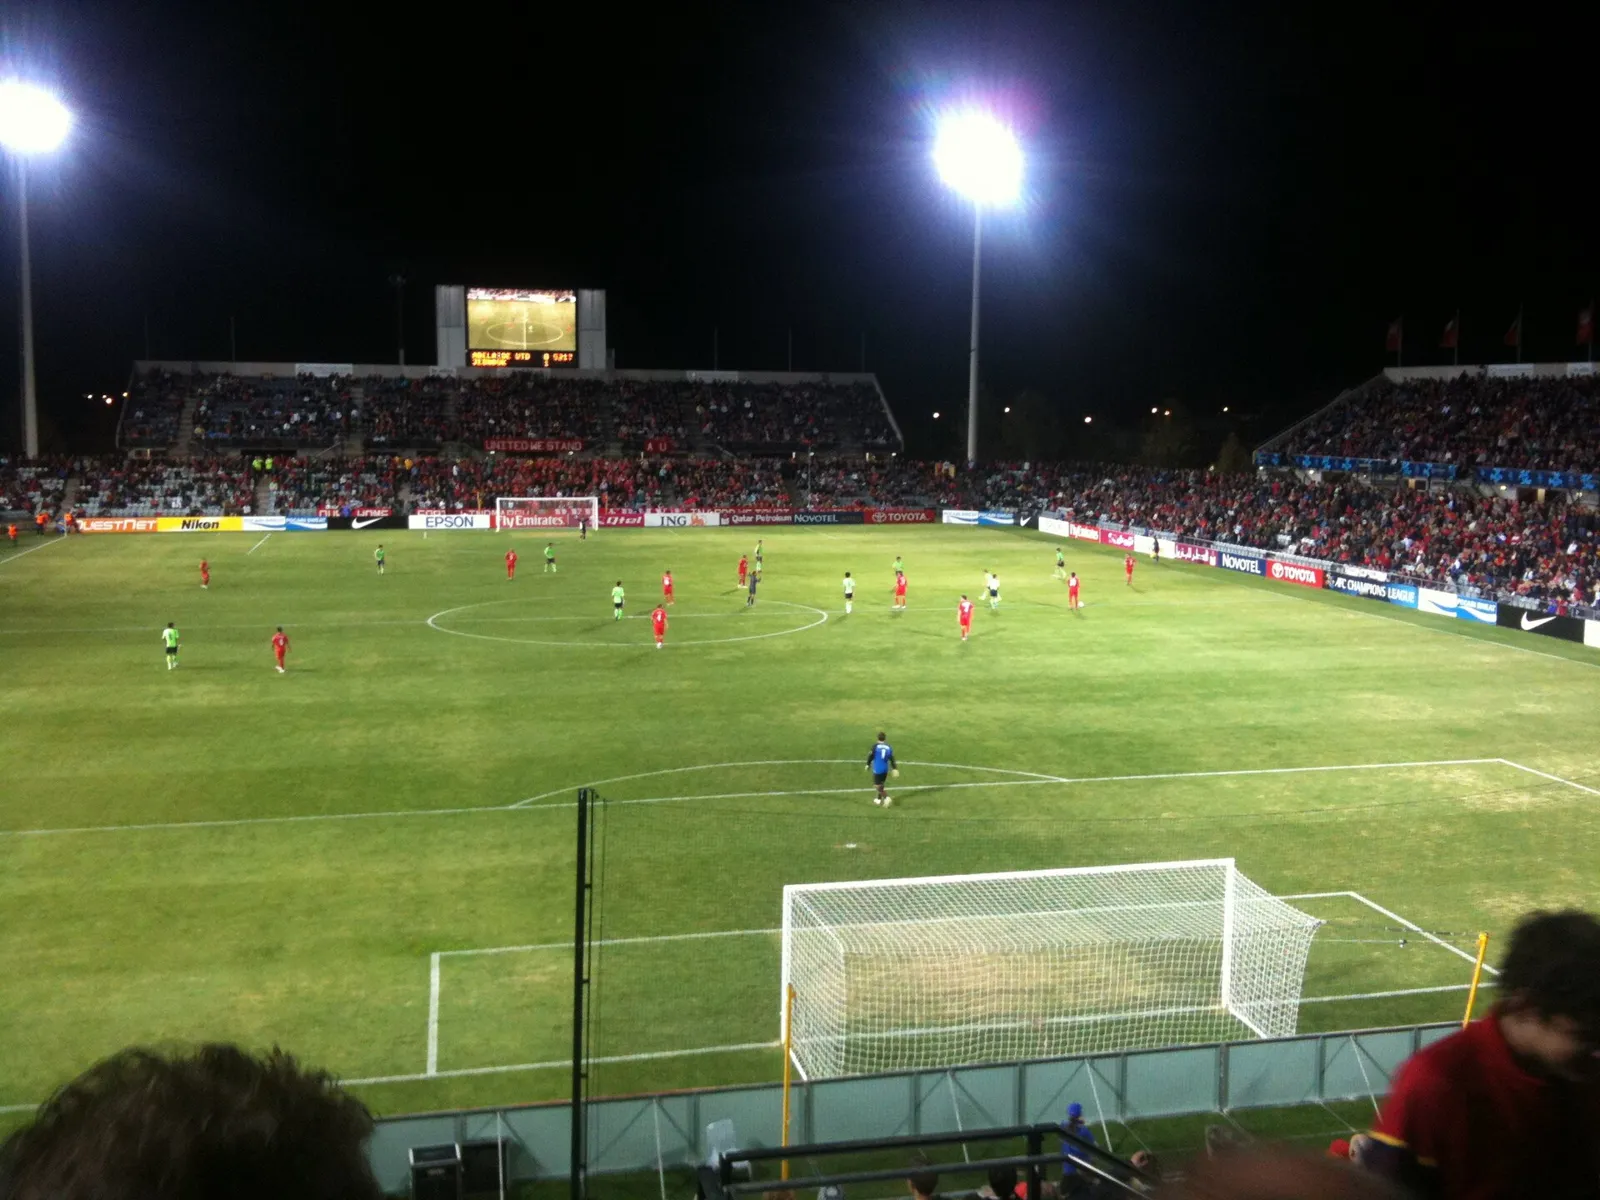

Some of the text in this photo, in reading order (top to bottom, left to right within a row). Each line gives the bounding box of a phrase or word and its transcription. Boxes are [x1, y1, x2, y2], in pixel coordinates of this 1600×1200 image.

[514, 352, 531, 361] UTD
[485, 440, 583, 451] UNITED WE STAND
[425, 516, 474, 528] EPSON
[515, 514, 564, 526] Emirates
[660, 515, 687, 526] ING
[732, 514, 792, 523] Qatar Petroleum
[794, 513, 838, 523] NOVOTEL
[887, 512, 927, 521] TOYOTA
[181, 519, 220, 530] Nikon
[1222, 553, 1261, 574] NOVOTEL
[1284, 566, 1317, 583] TOYOTA
[1335, 577, 1416, 604] AFC CHAMPIONS LEAGUE
